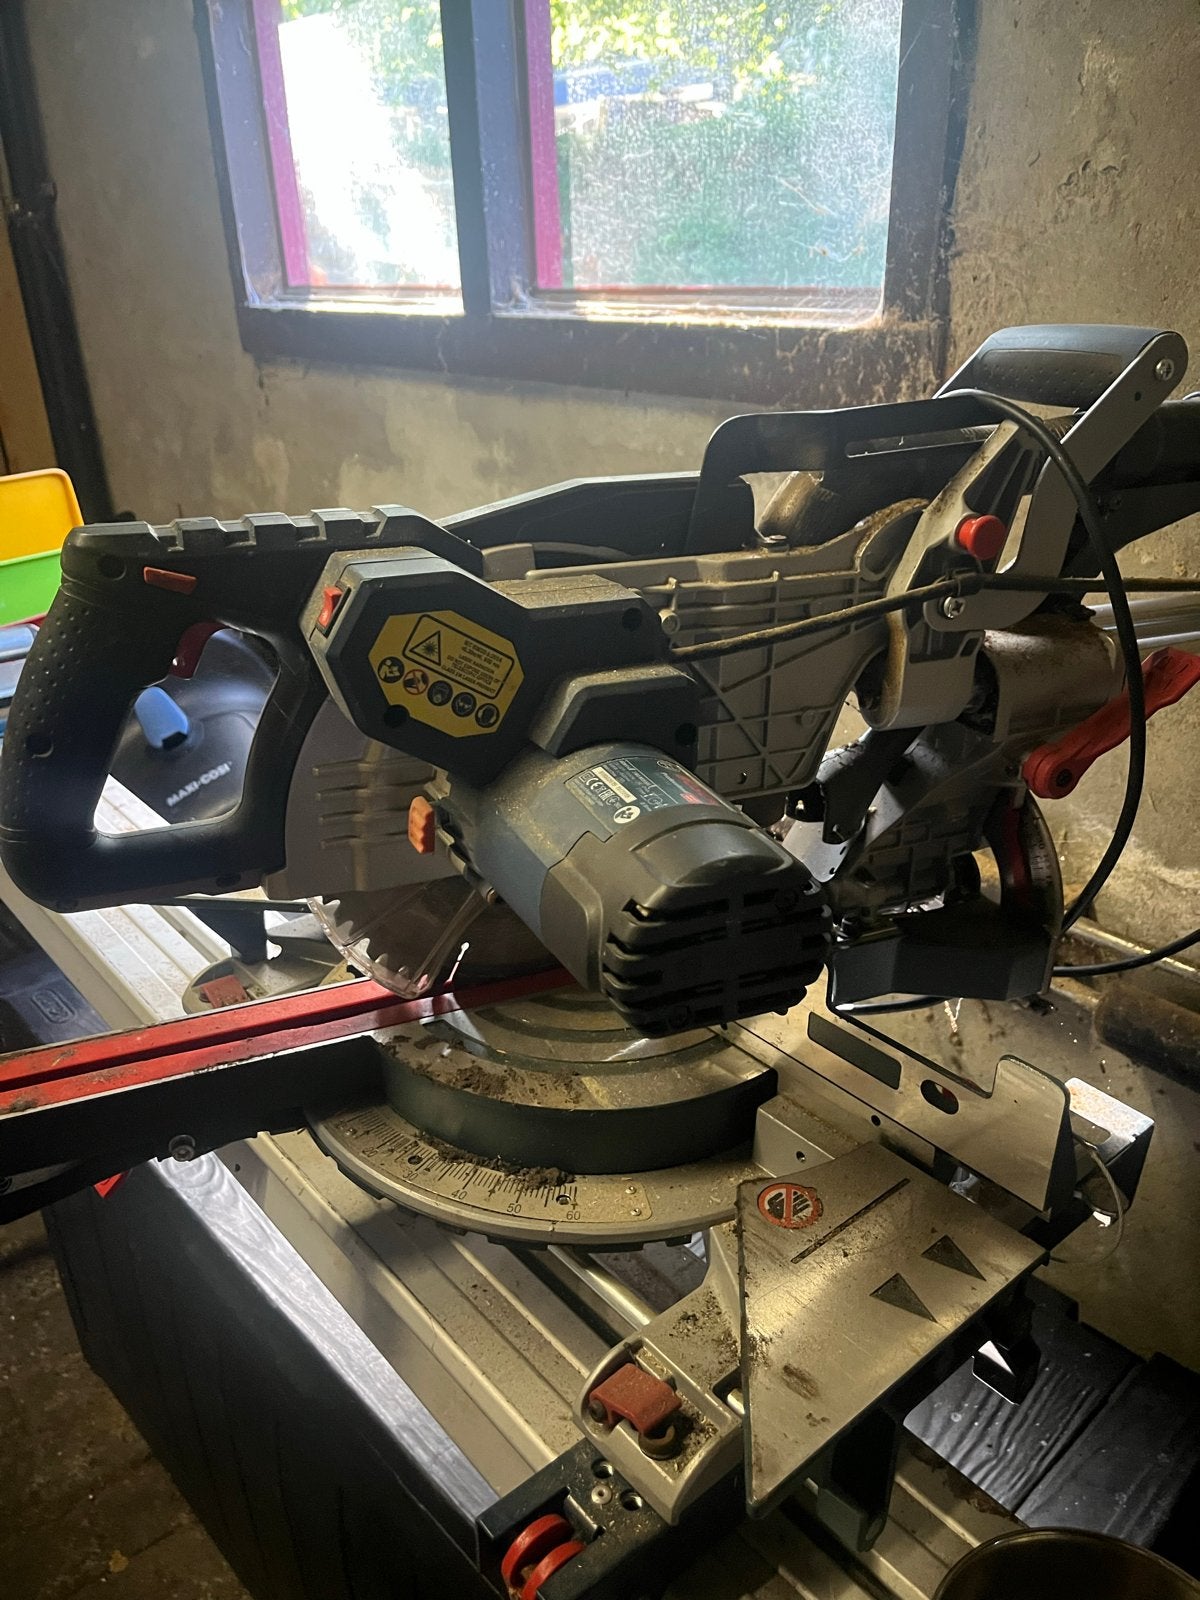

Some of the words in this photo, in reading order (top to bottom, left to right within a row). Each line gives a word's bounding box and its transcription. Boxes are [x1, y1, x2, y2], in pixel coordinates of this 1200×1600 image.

[166, 762, 231, 806] MAXI-COSI
[362, 1147, 378, 1158] 20
[402, 1170, 419, 1181] 30
[450, 1189, 468, 1200] 40
[506, 1203, 522, 1214] 50
[566, 1210, 581, 1221] 60
